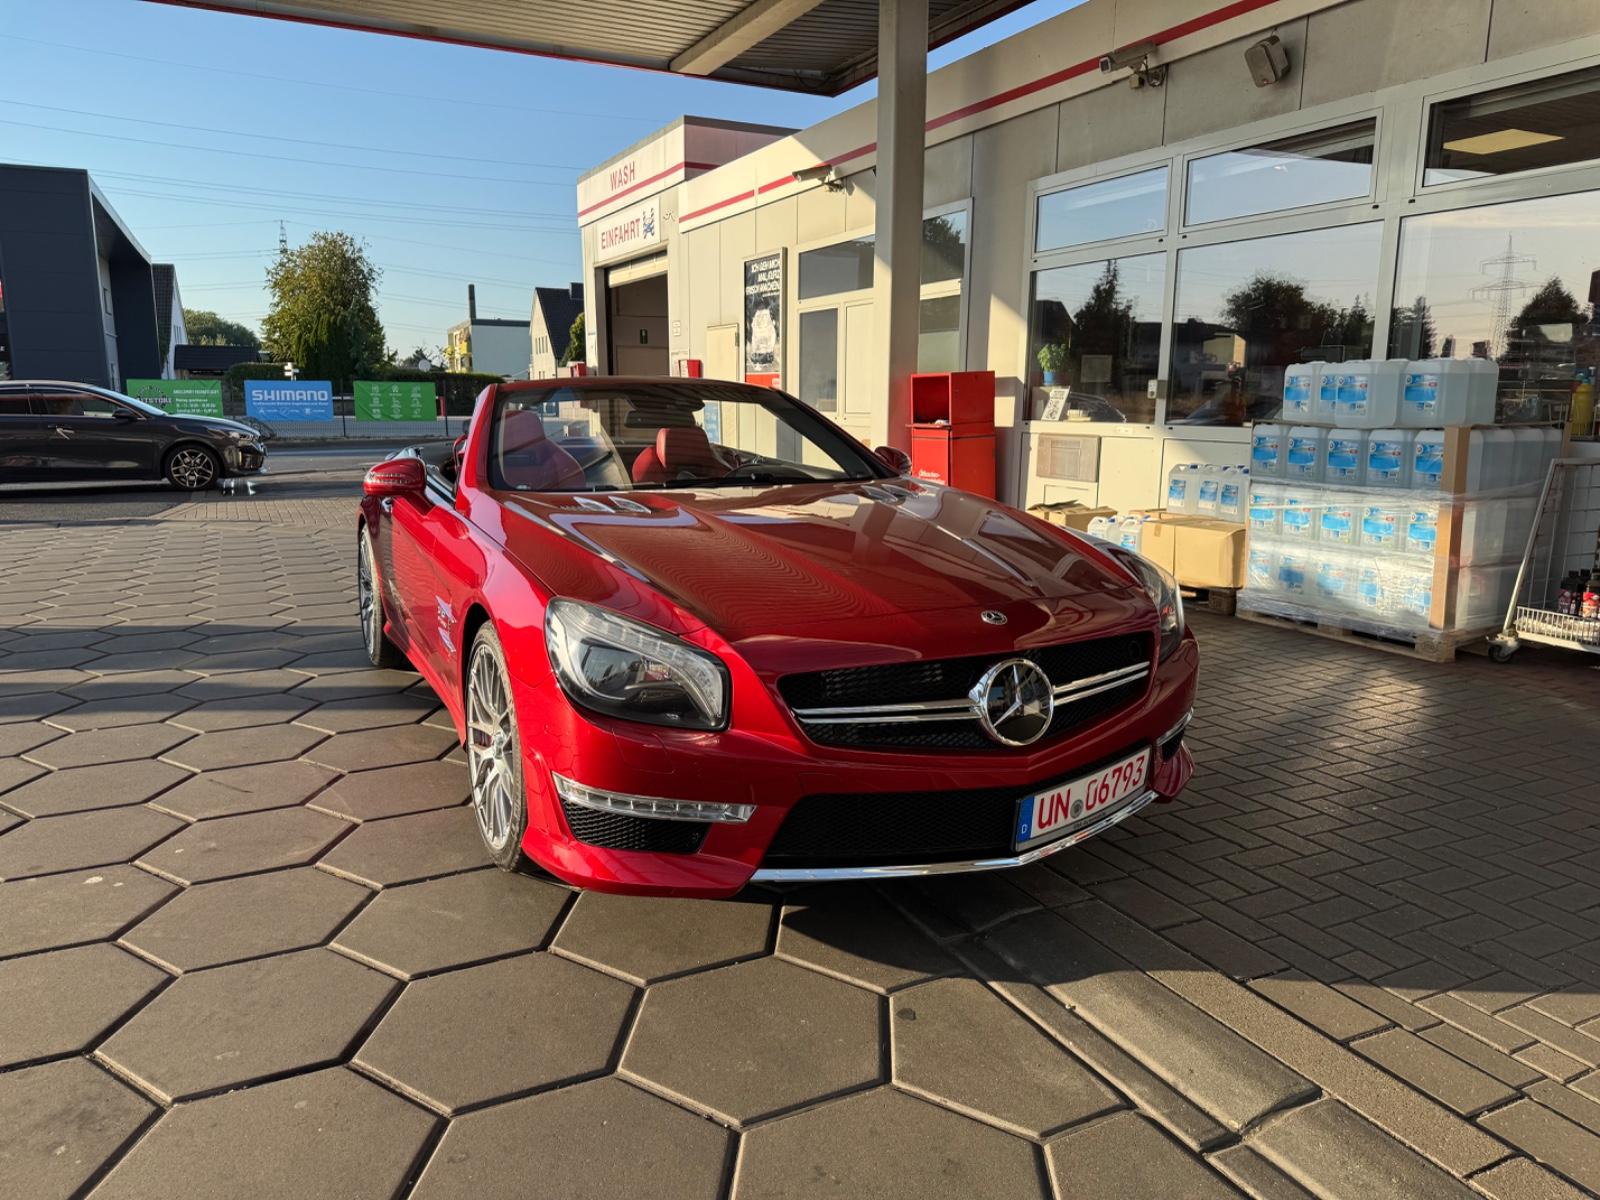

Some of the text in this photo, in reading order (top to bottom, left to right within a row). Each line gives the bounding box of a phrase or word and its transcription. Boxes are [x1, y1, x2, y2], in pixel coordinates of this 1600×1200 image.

[610, 160, 635, 191] WASH
[601, 218, 640, 250] EINFAHRT
[252, 389, 328, 401] SHIMANO
[1037, 755, 1145, 829] UN 06793
[1021, 824, 1028, 834] D
